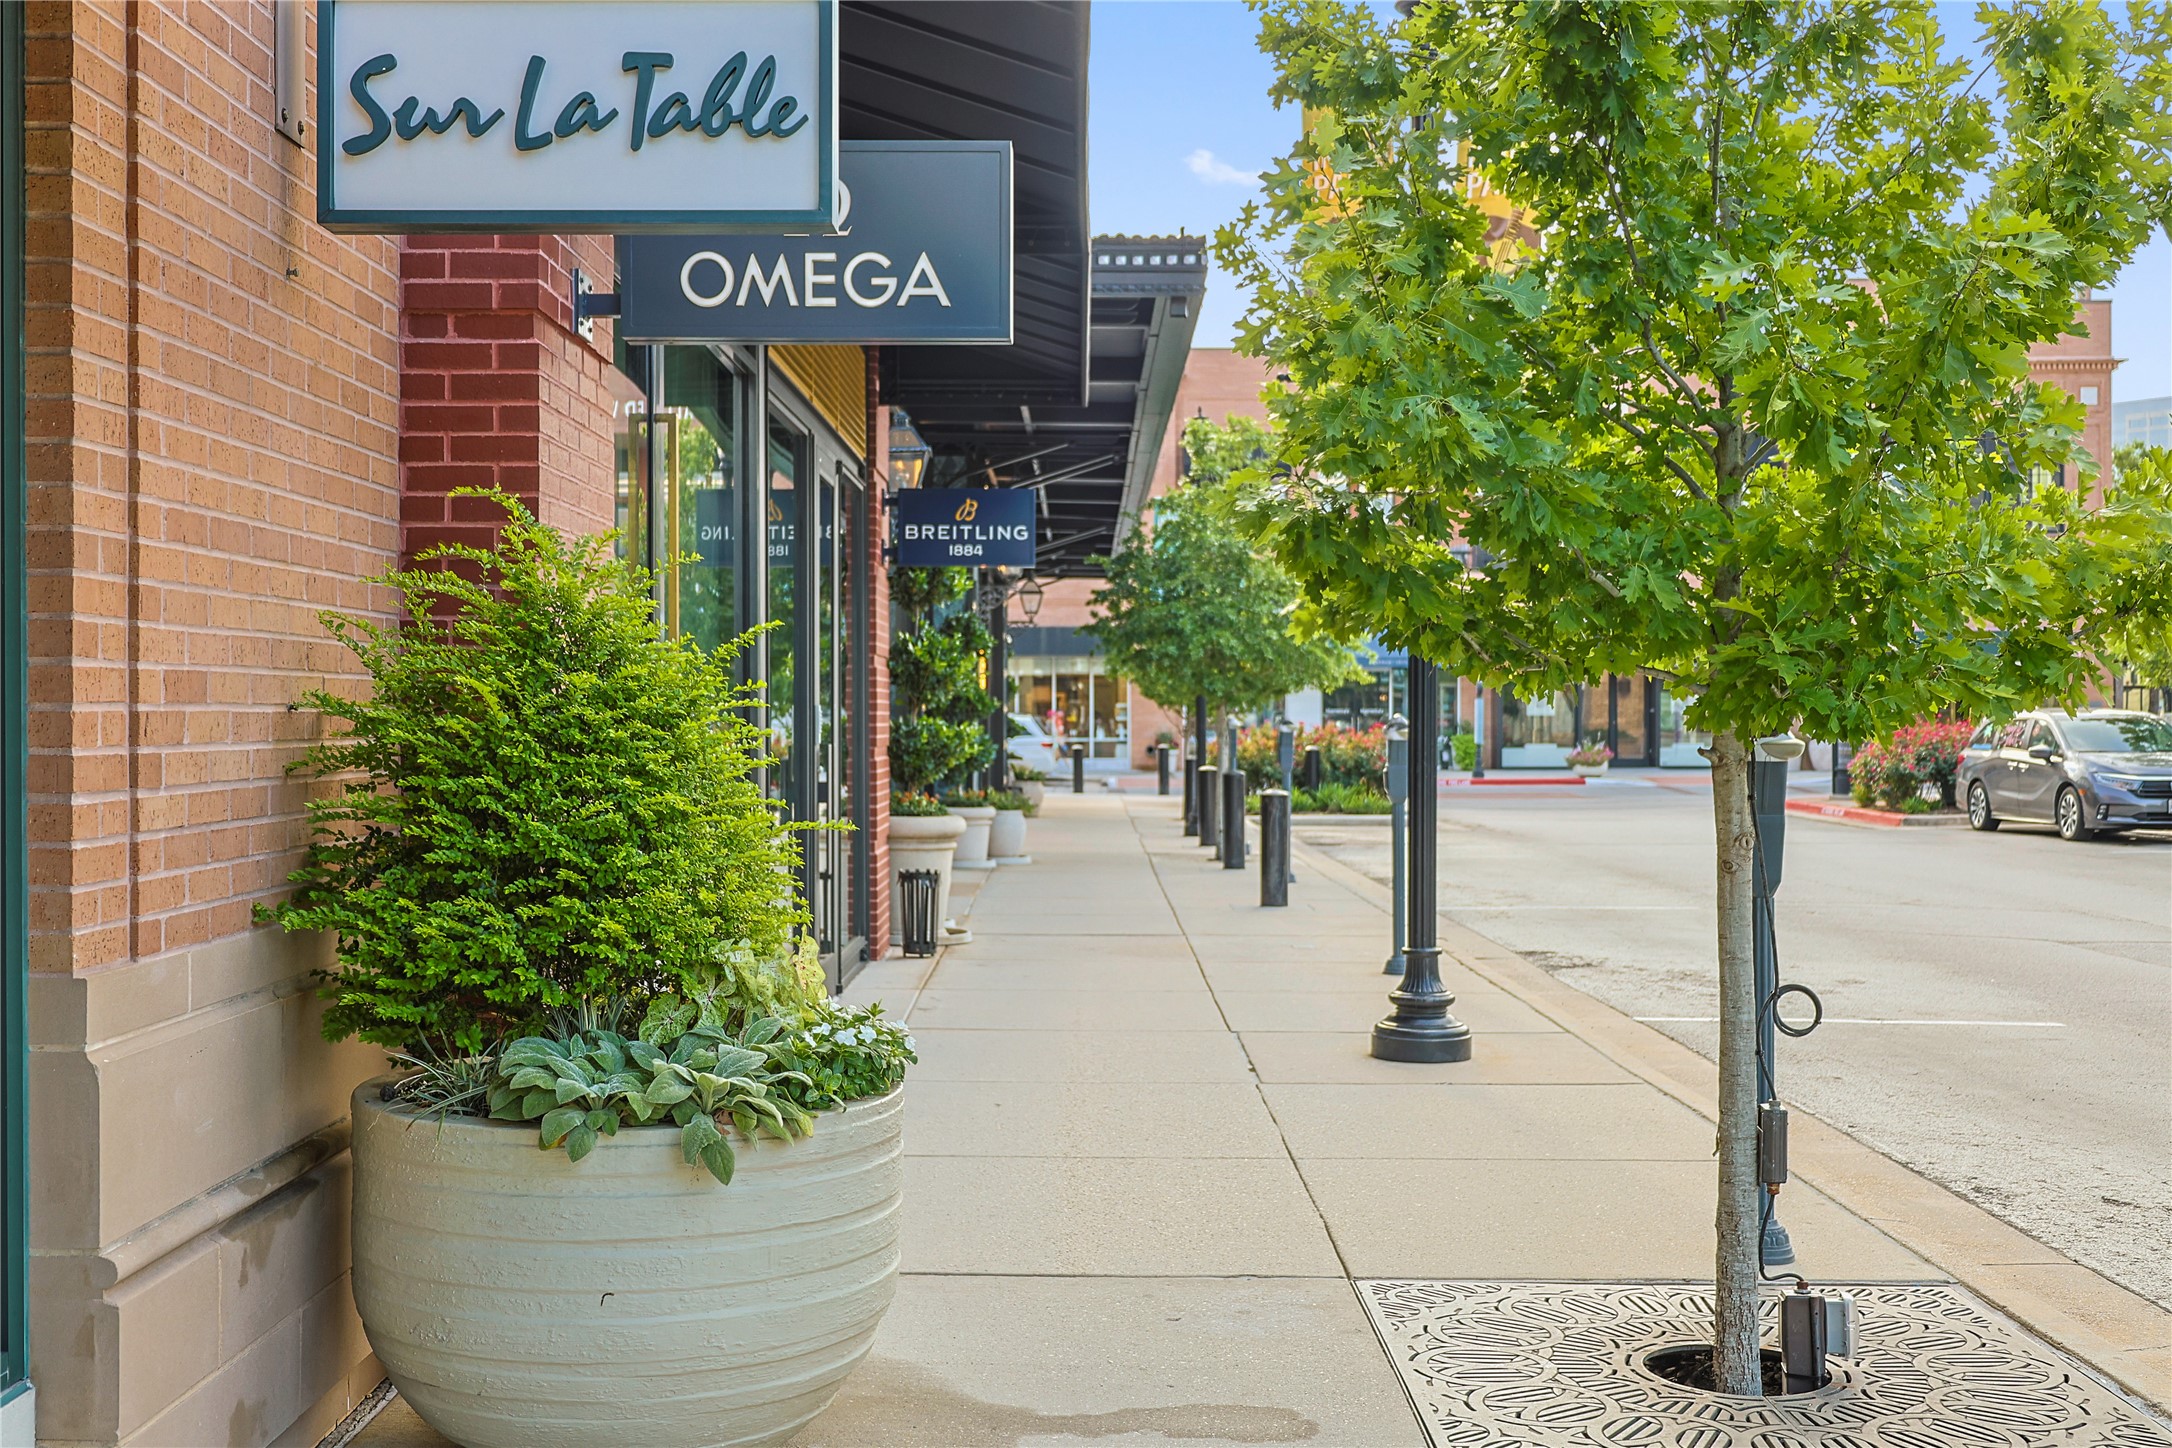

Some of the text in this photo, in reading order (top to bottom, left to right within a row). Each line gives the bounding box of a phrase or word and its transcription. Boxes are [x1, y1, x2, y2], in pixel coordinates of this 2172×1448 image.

[341, 51, 809, 156] Sur La Table
[680, 250, 952, 308] OMEGA
[904, 524, 1029, 540] BREITLING
[948, 544, 983, 556] 1884
